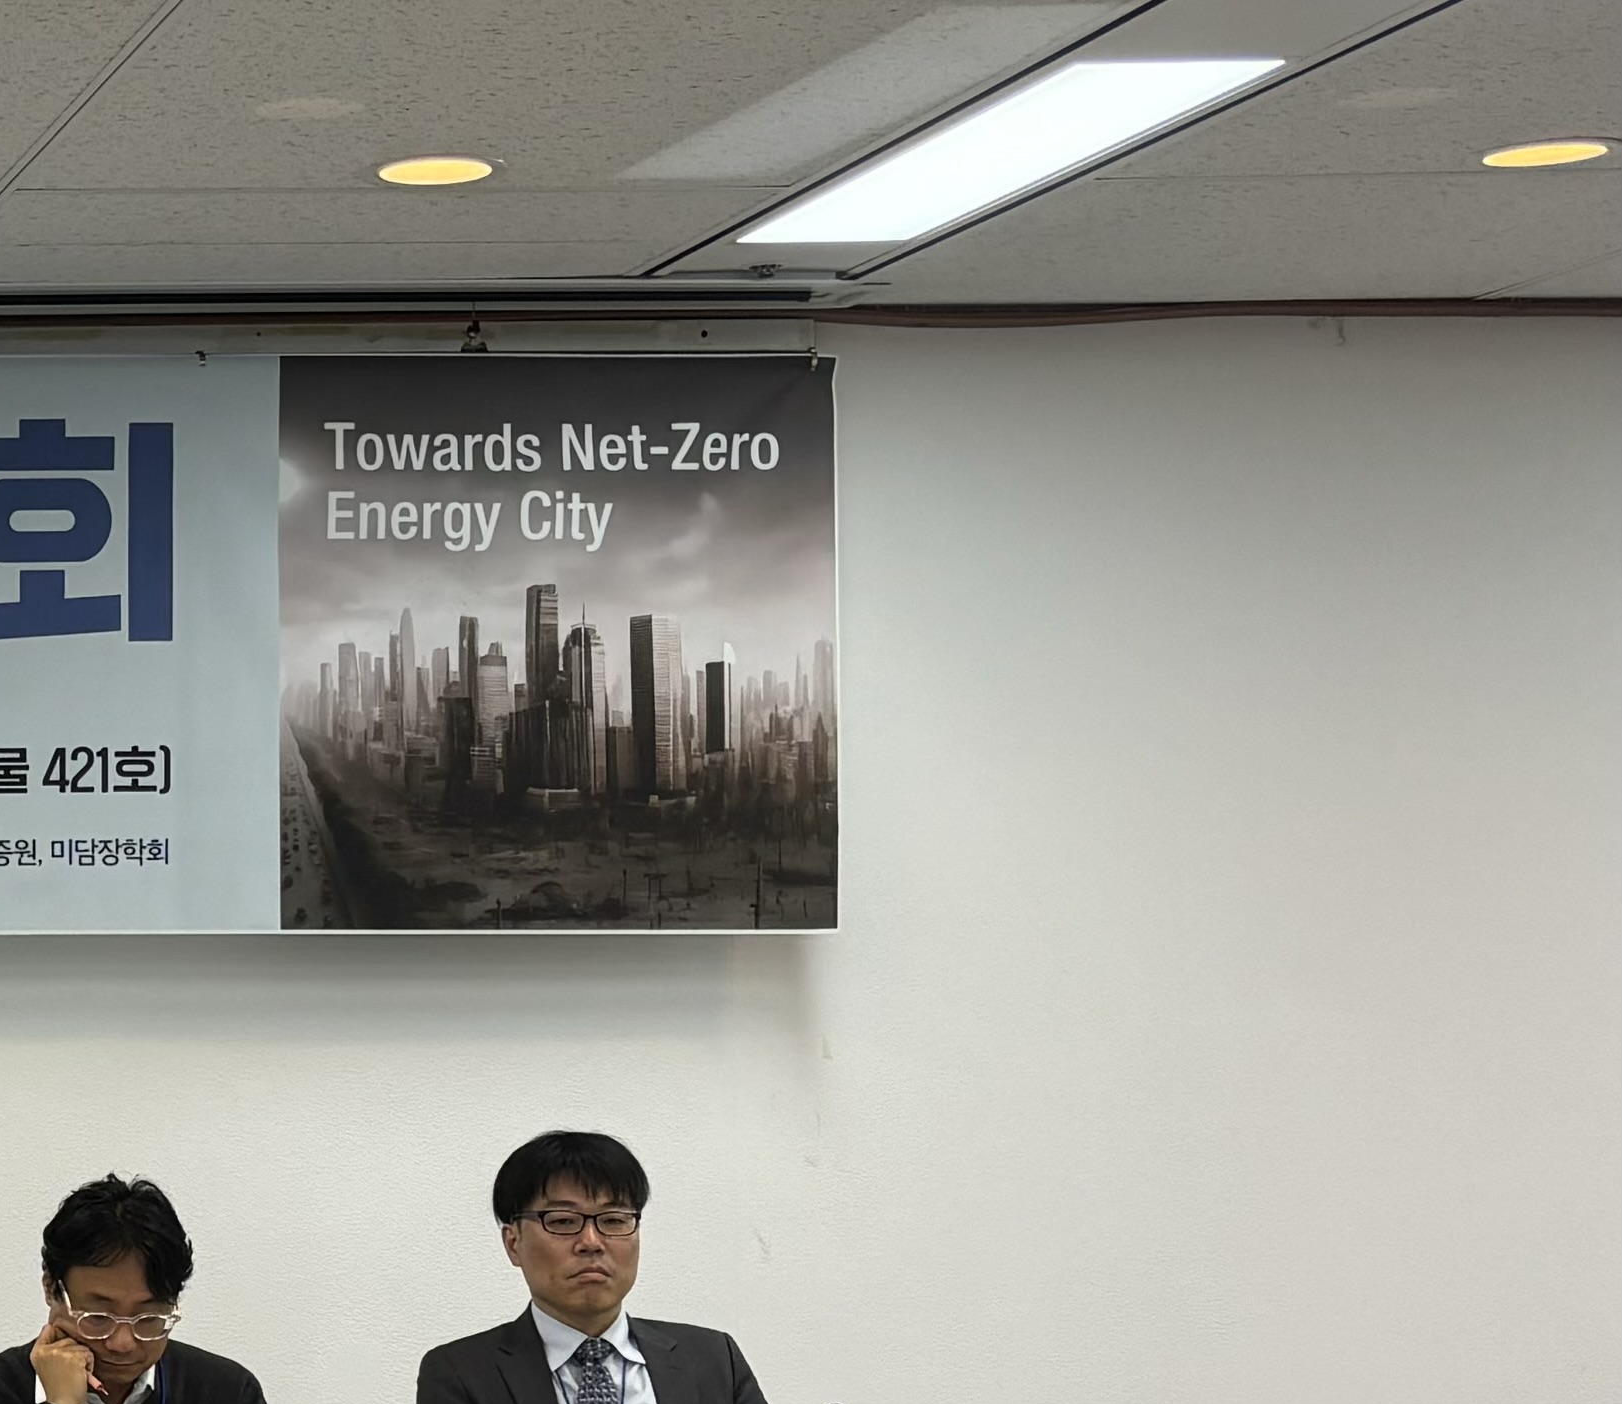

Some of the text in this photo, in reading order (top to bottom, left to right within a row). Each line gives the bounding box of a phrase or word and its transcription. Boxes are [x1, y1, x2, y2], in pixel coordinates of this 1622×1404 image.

[324, 422, 780, 473] Towards Net-Zero
[327, 490, 614, 552] Energy City
[42, 744, 171, 795] 421호)
[50, 838, 169, 867] 미담장학회
